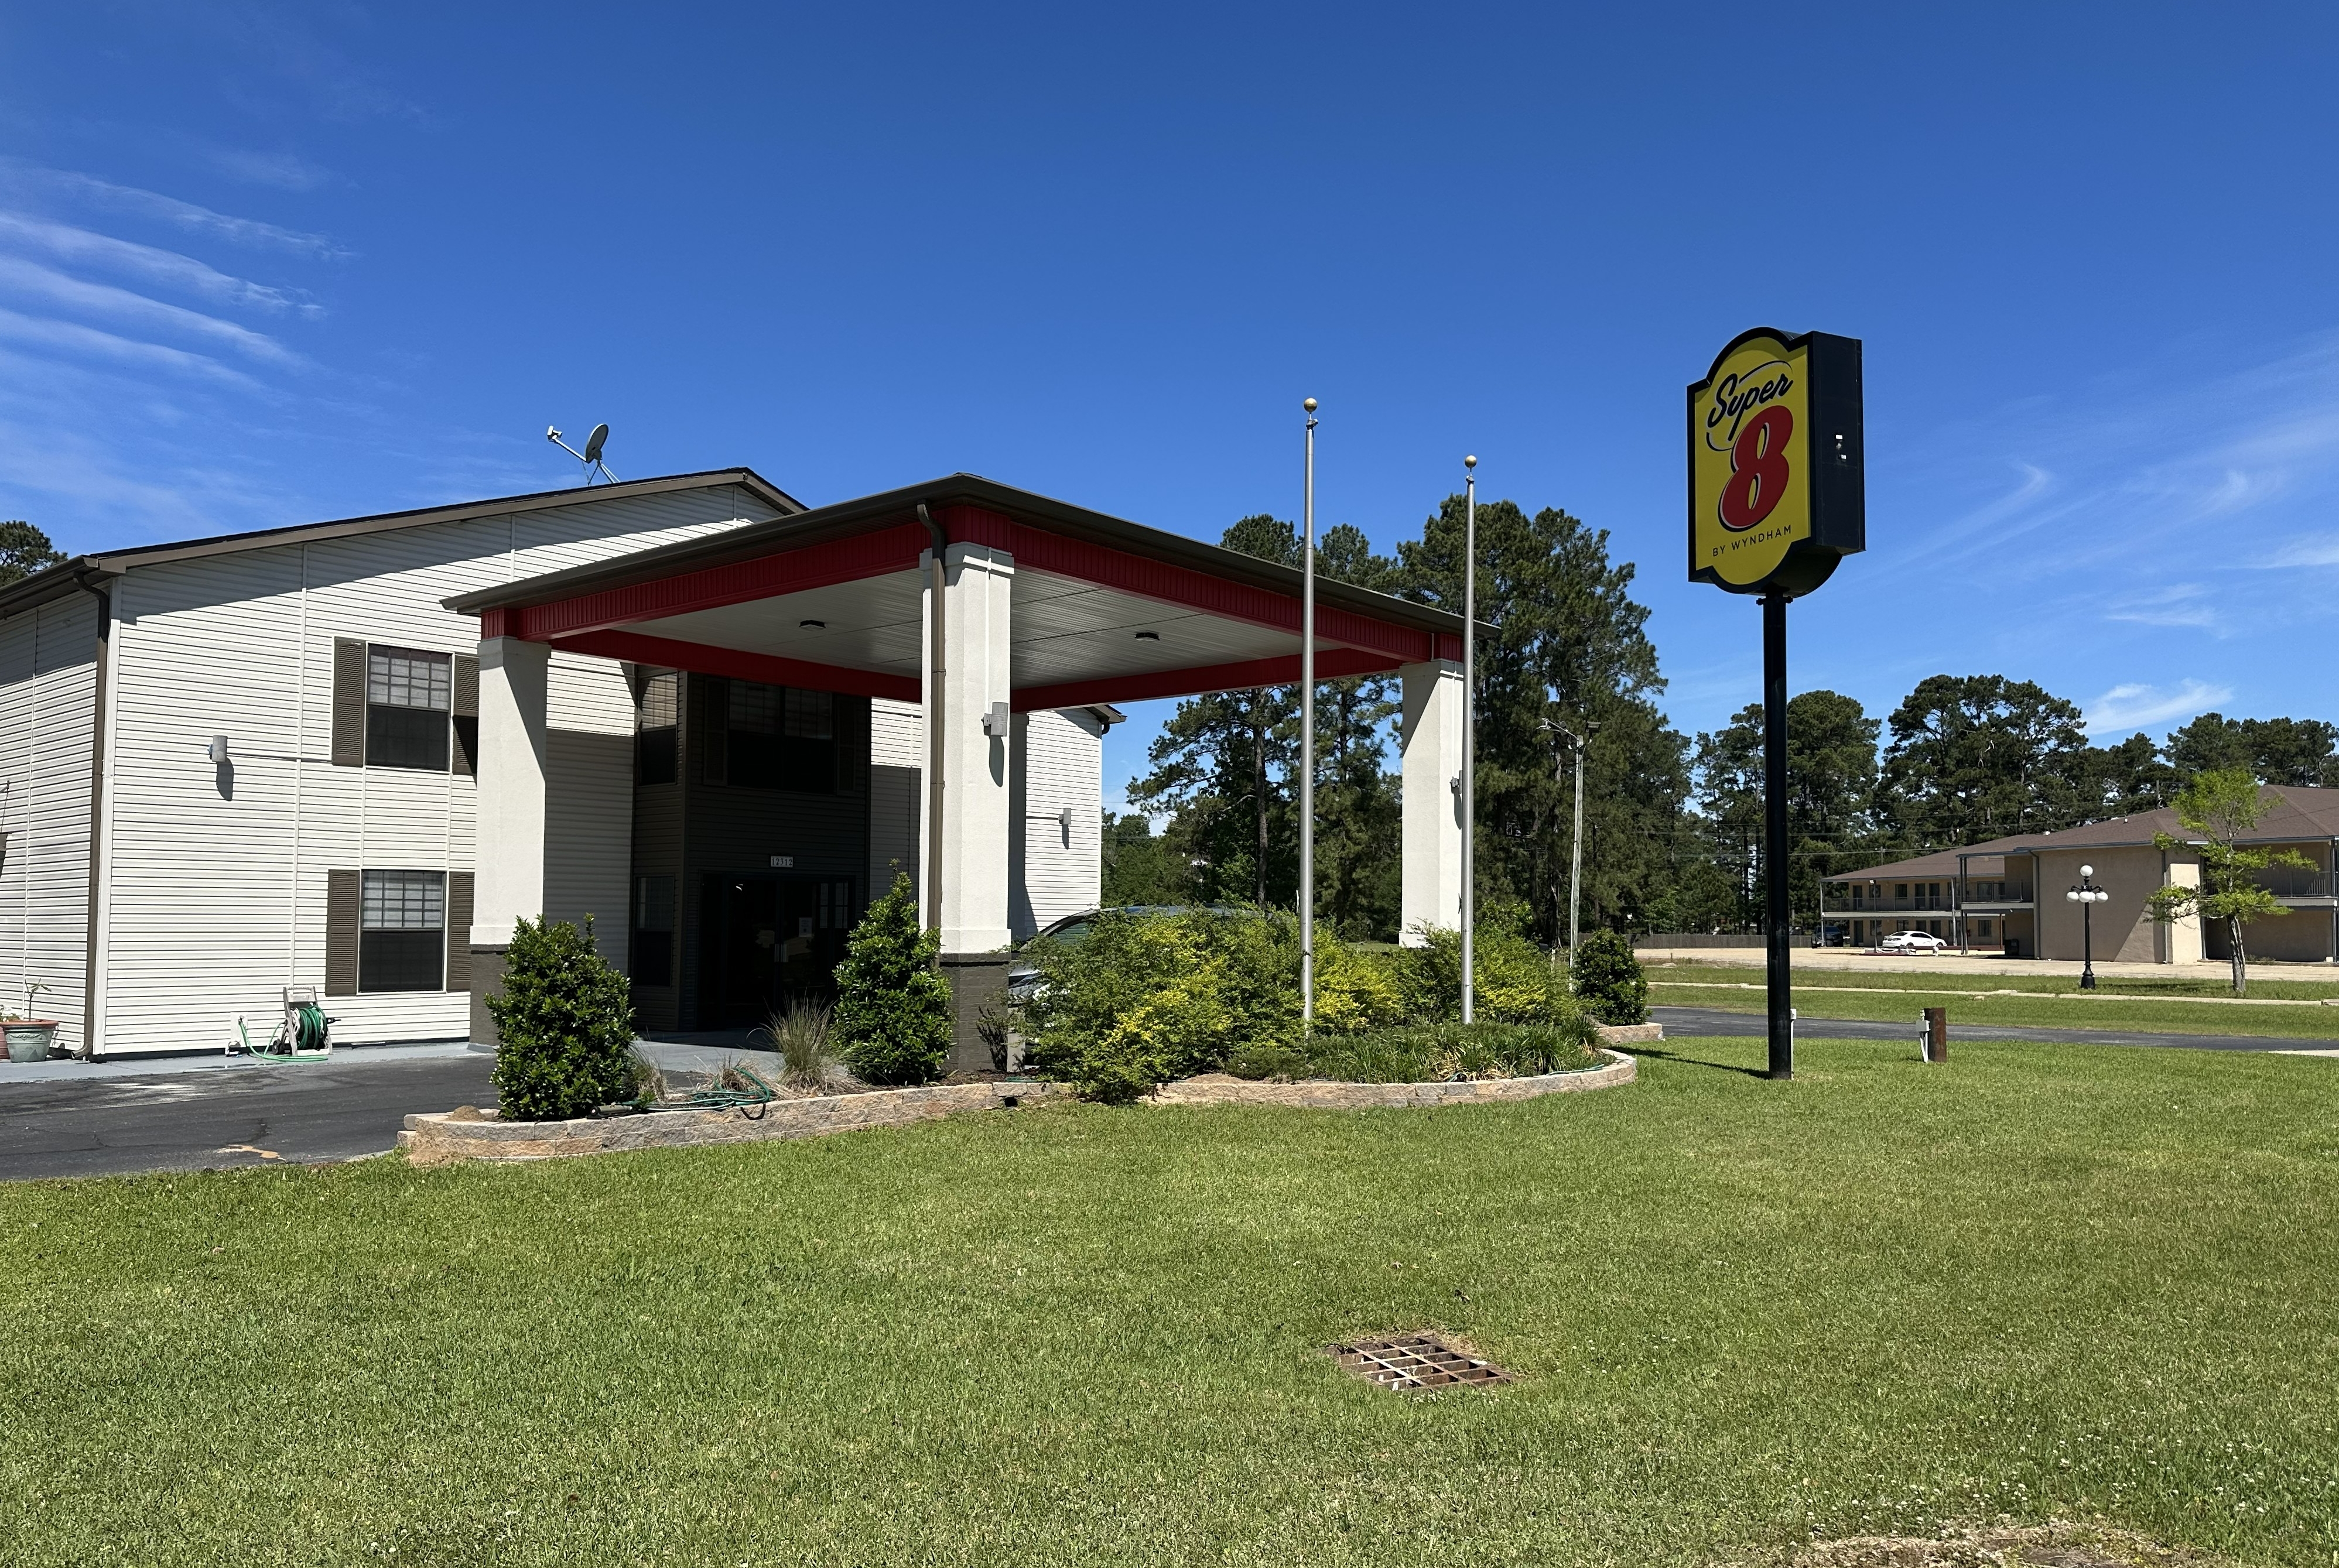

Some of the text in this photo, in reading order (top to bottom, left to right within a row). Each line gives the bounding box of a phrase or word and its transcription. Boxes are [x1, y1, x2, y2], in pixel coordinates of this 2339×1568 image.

[1707, 372, 1794, 441] Super
[1717, 405, 1794, 533] 8
[1712, 524, 1791, 557] BY WYNDHAM
[772, 857, 792, 866] 12312
